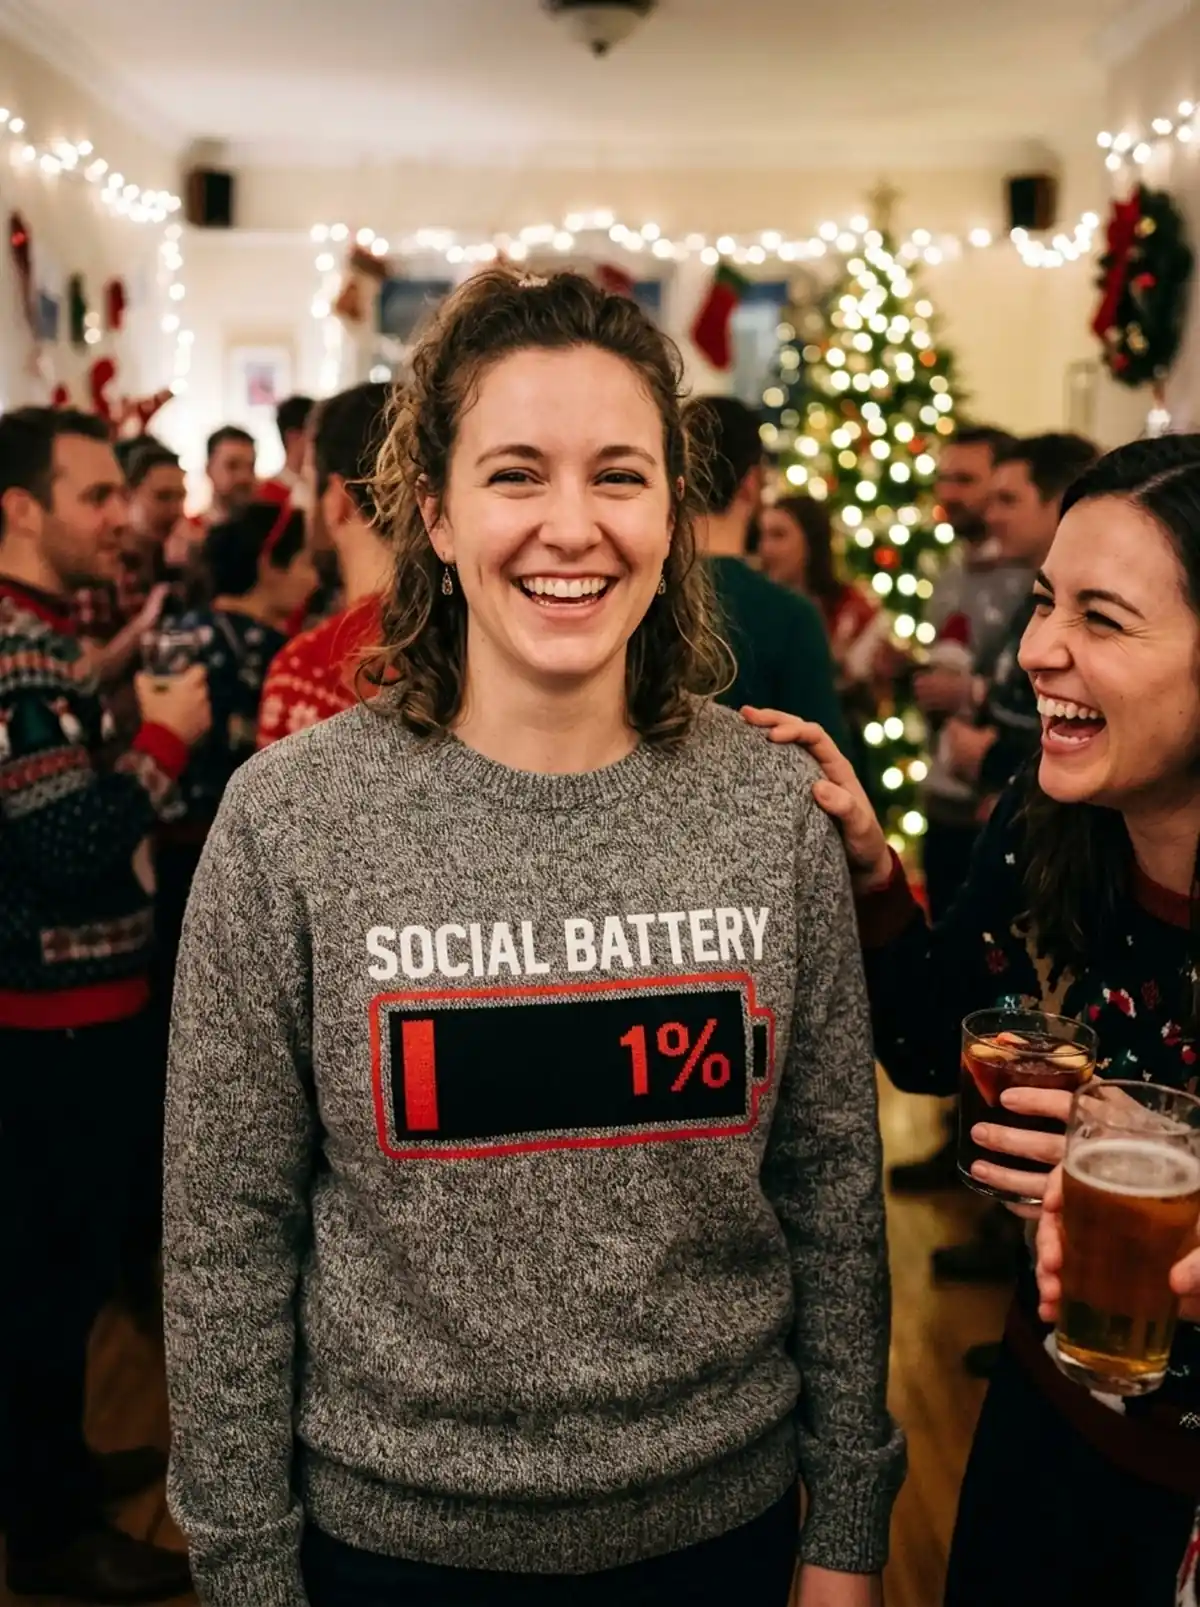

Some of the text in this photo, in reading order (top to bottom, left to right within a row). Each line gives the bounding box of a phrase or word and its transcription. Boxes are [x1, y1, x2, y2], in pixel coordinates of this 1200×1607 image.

[366, 907, 769, 980] SOCIAL BATTERY
[620, 1018, 730, 1096] 1%
